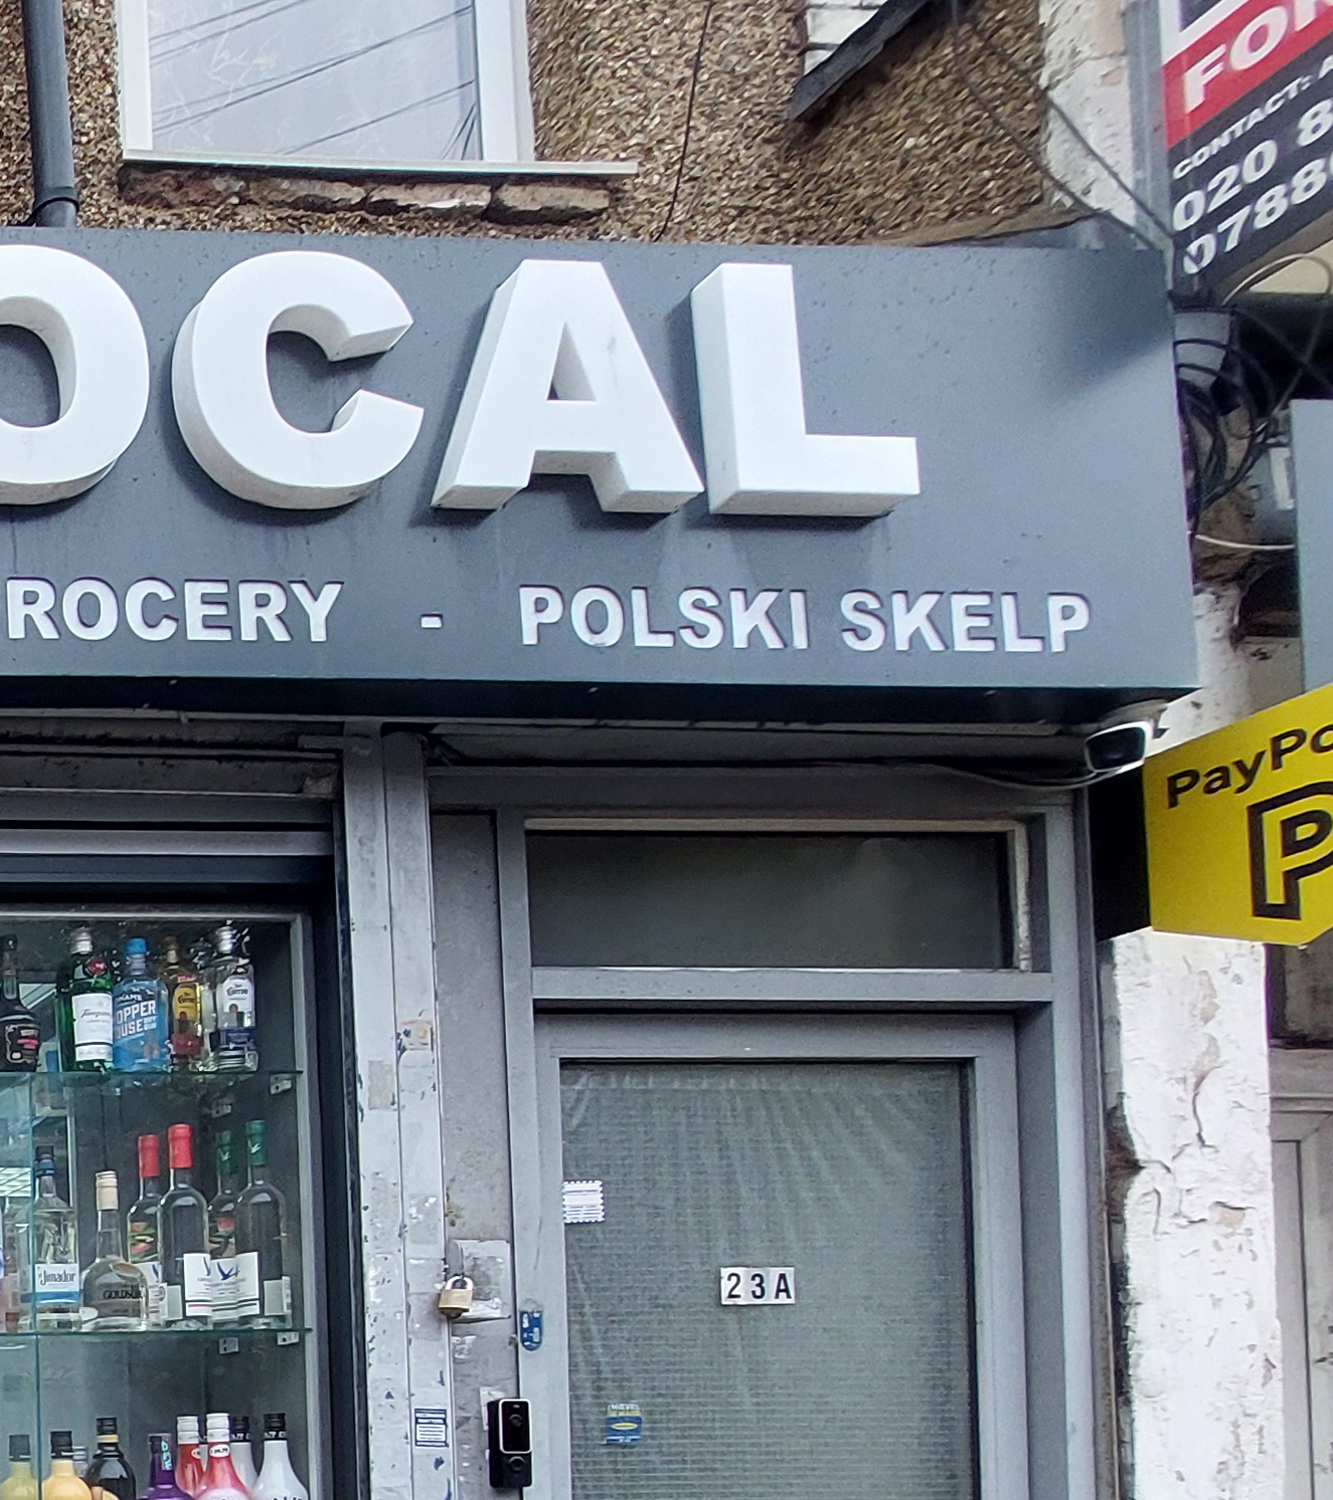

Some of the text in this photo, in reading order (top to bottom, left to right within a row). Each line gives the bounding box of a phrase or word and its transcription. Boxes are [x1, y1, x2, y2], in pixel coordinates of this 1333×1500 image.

[1173, 140, 1278, 231] 020
[518, 587, 809, 650] POLSKI
[839, 592, 1091, 656] SKELP
